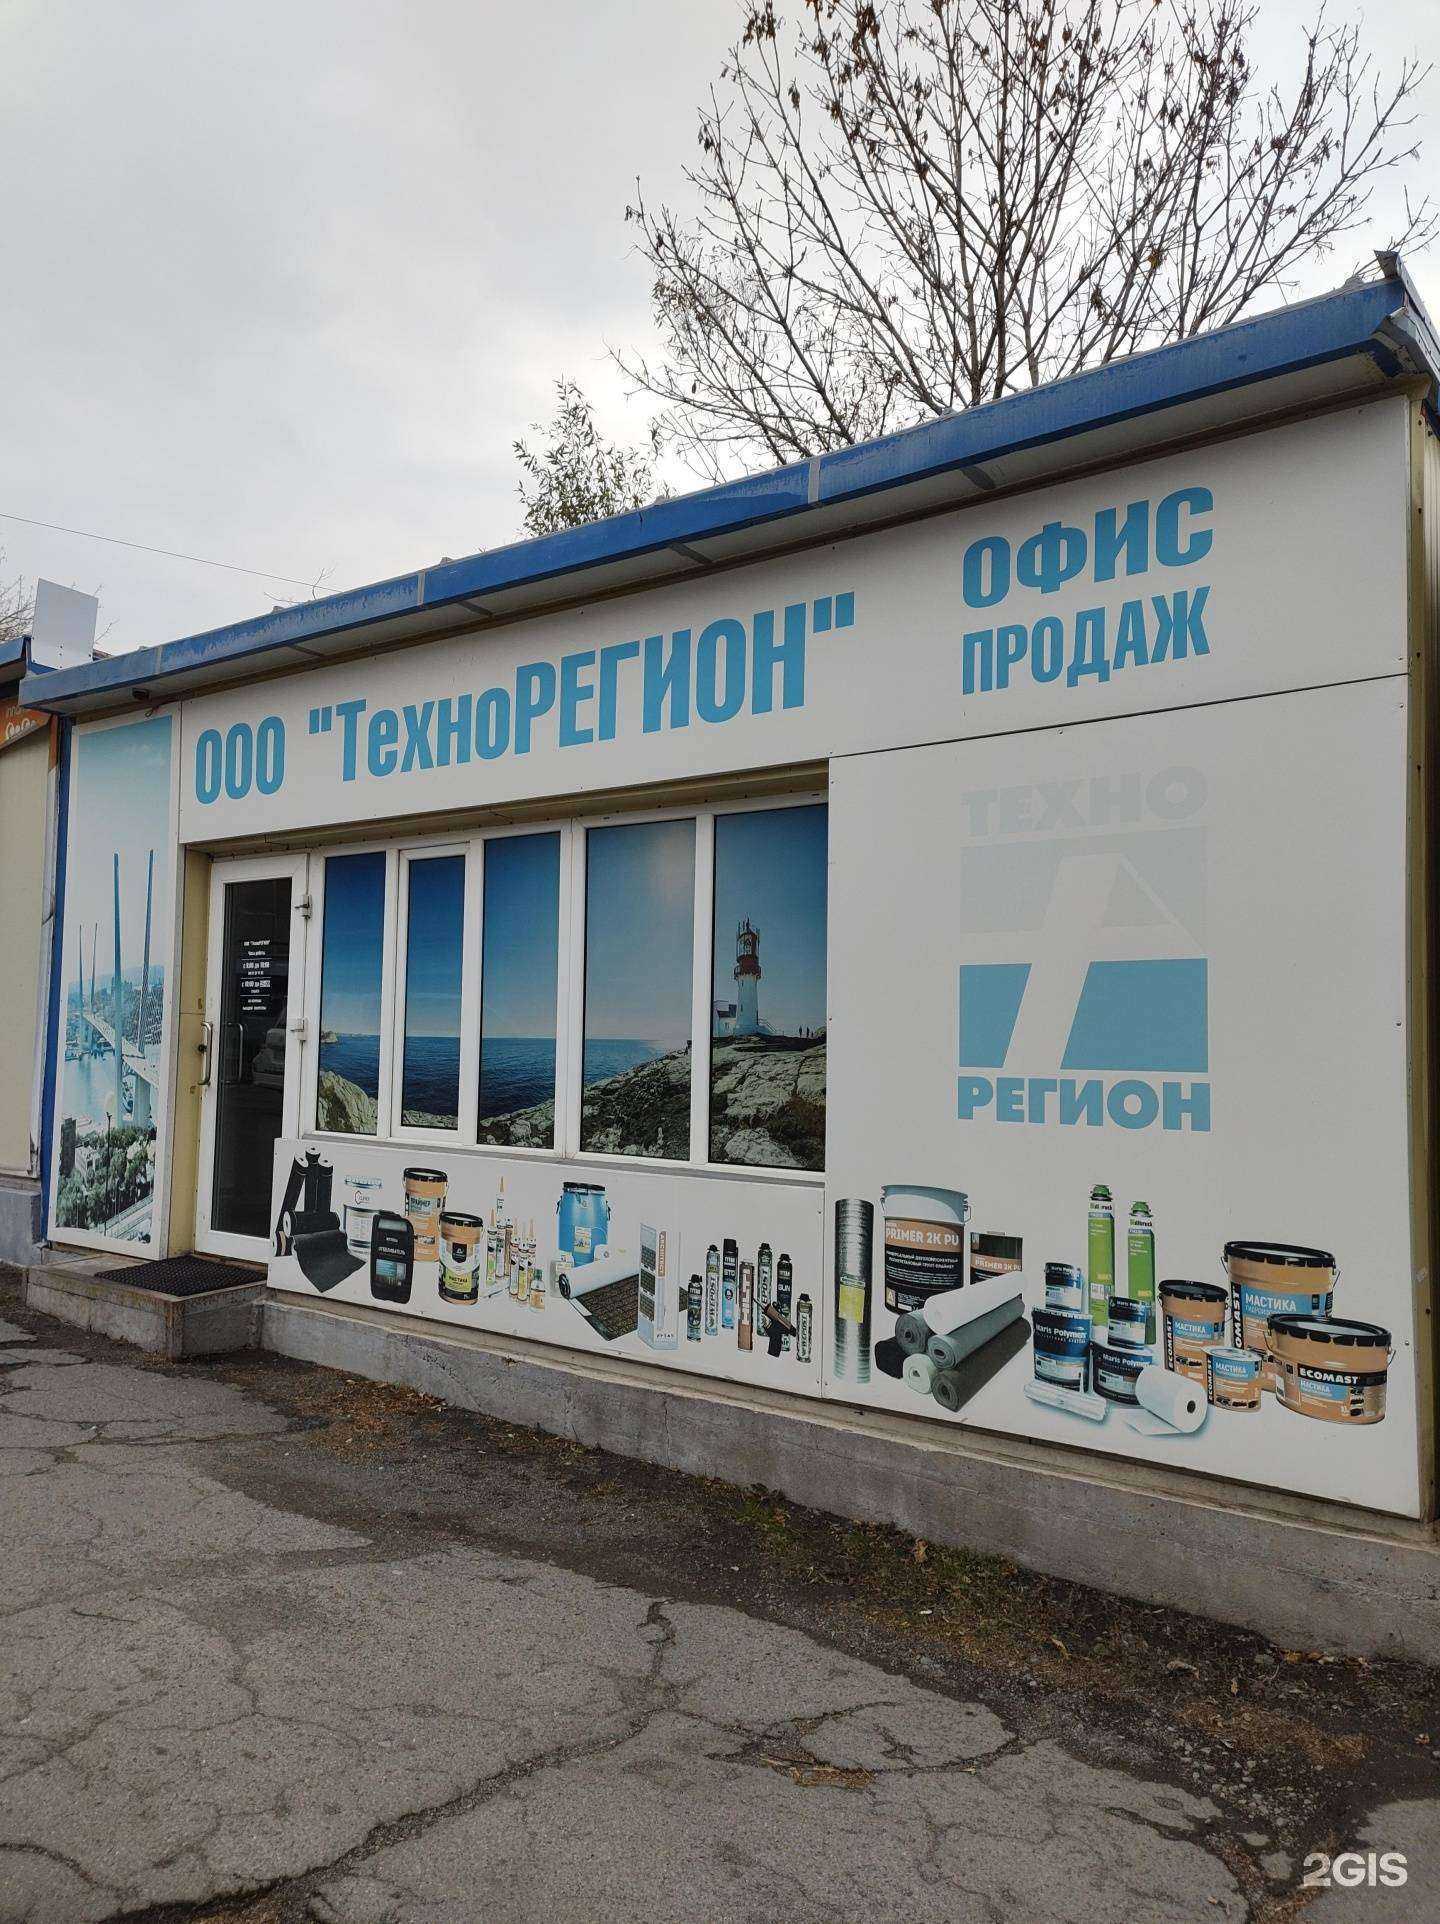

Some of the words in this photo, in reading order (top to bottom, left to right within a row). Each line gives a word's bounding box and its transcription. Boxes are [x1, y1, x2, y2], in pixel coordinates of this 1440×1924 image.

[963, 487, 1213, 608] ОФИС
[963, 587, 1210, 694] ПРОДАЖ
[196, 717, 284, 804] ООО
[308, 593, 855, 781] "ТехноРЕГИОН"
[963, 766, 1208, 838] ТЕХНО
[958, 1077, 1208, 1131] РЕГИОН
[886, 1228, 924, 1244] PRIMER
[926, 1232, 942, 1245] 2K
[944, 1235, 959, 1246] PU
[1232, 1284, 1243, 1348] OMAST
[1245, 1292, 1297, 1312] МАСТИКА
[1174, 1321, 1206, 1334] МАСТИКА
[1103, 1353, 1121, 1364] Maris
[1216, 1362, 1247, 1374] МАСТИКА
[1299, 1367, 1359, 1384] ECOMAST
